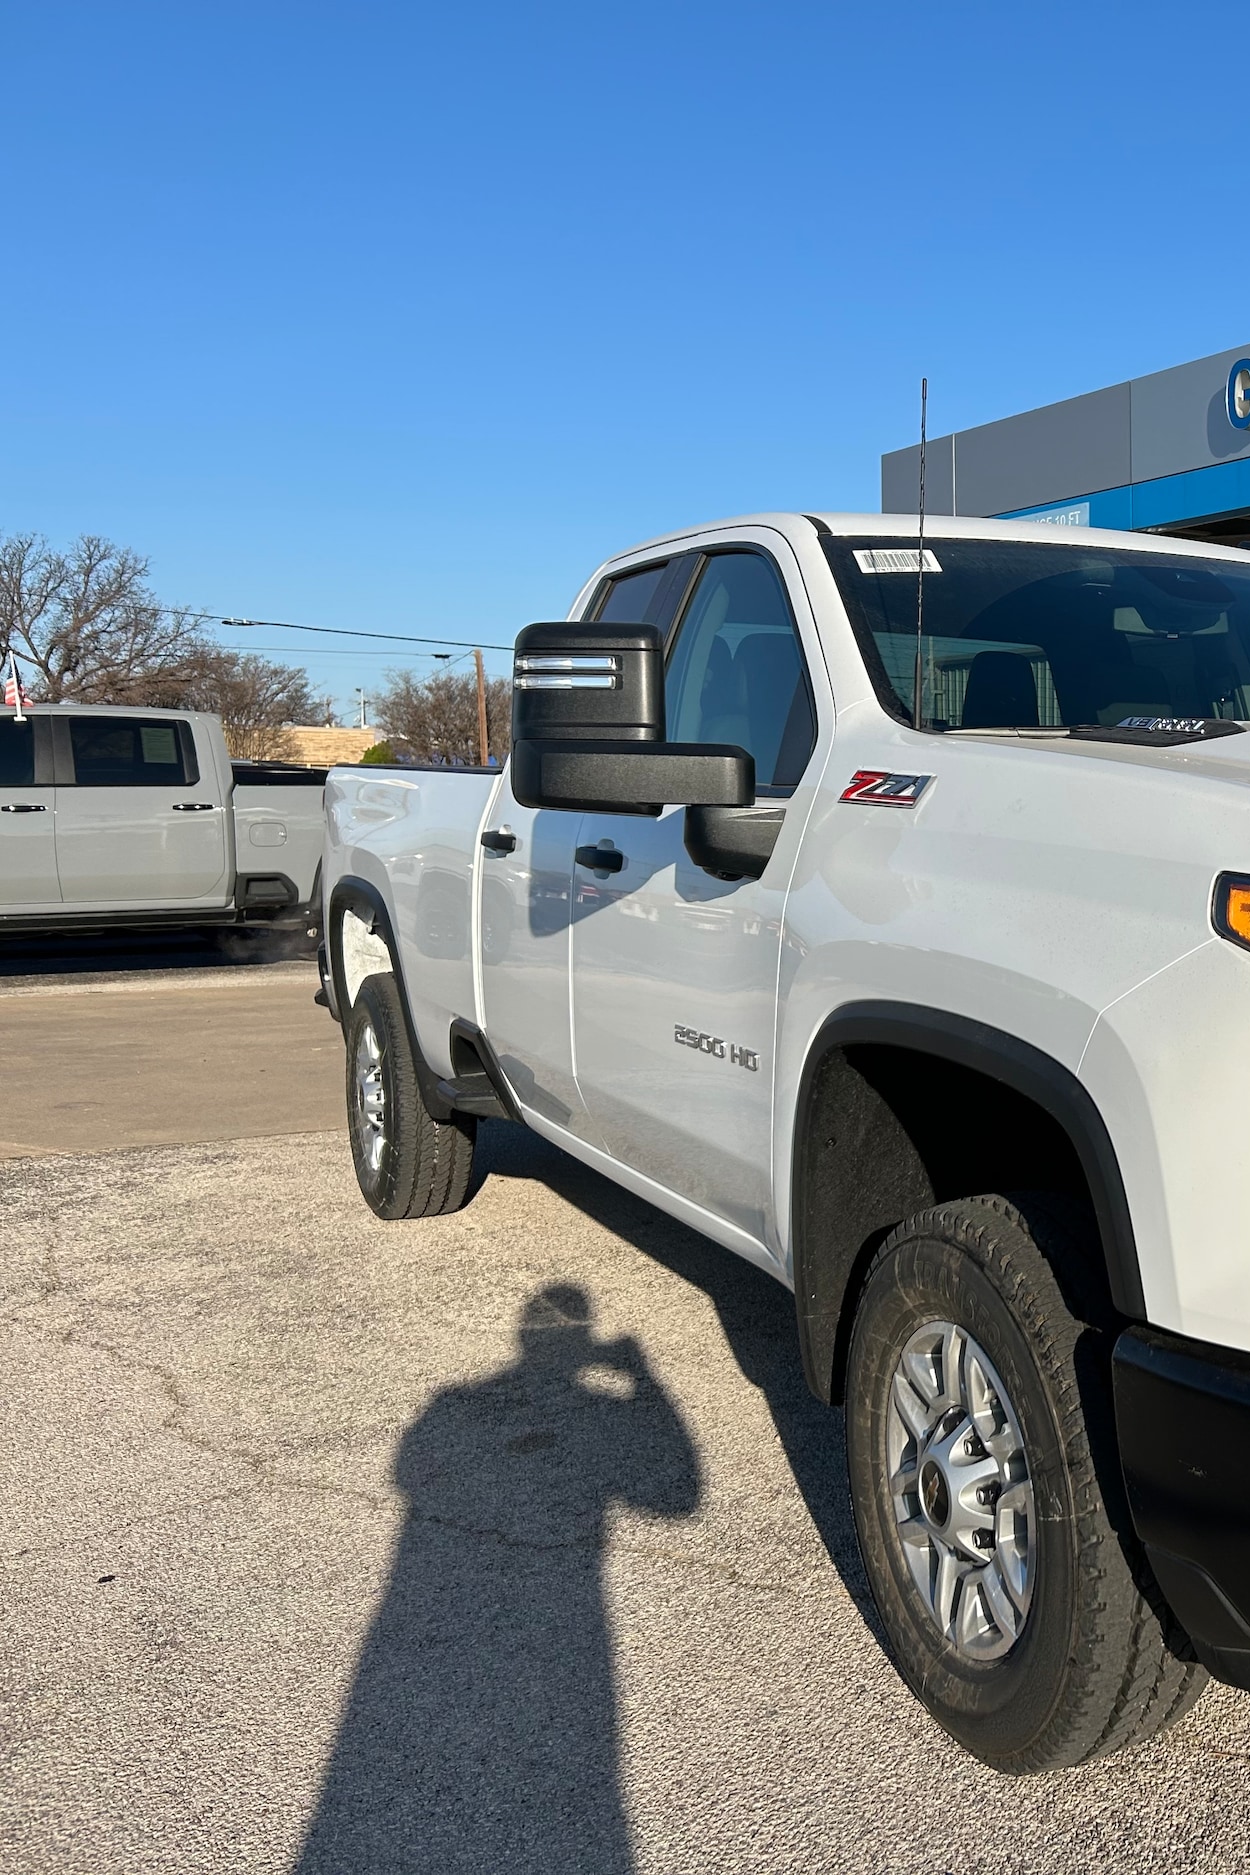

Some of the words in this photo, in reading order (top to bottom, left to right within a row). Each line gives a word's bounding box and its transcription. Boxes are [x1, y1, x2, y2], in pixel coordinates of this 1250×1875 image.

[1068, 510, 1081, 526] FT
[838, 769, 937, 809] Z71
[674, 1023, 727, 1059] 2500
[730, 1043, 760, 1072] HD
